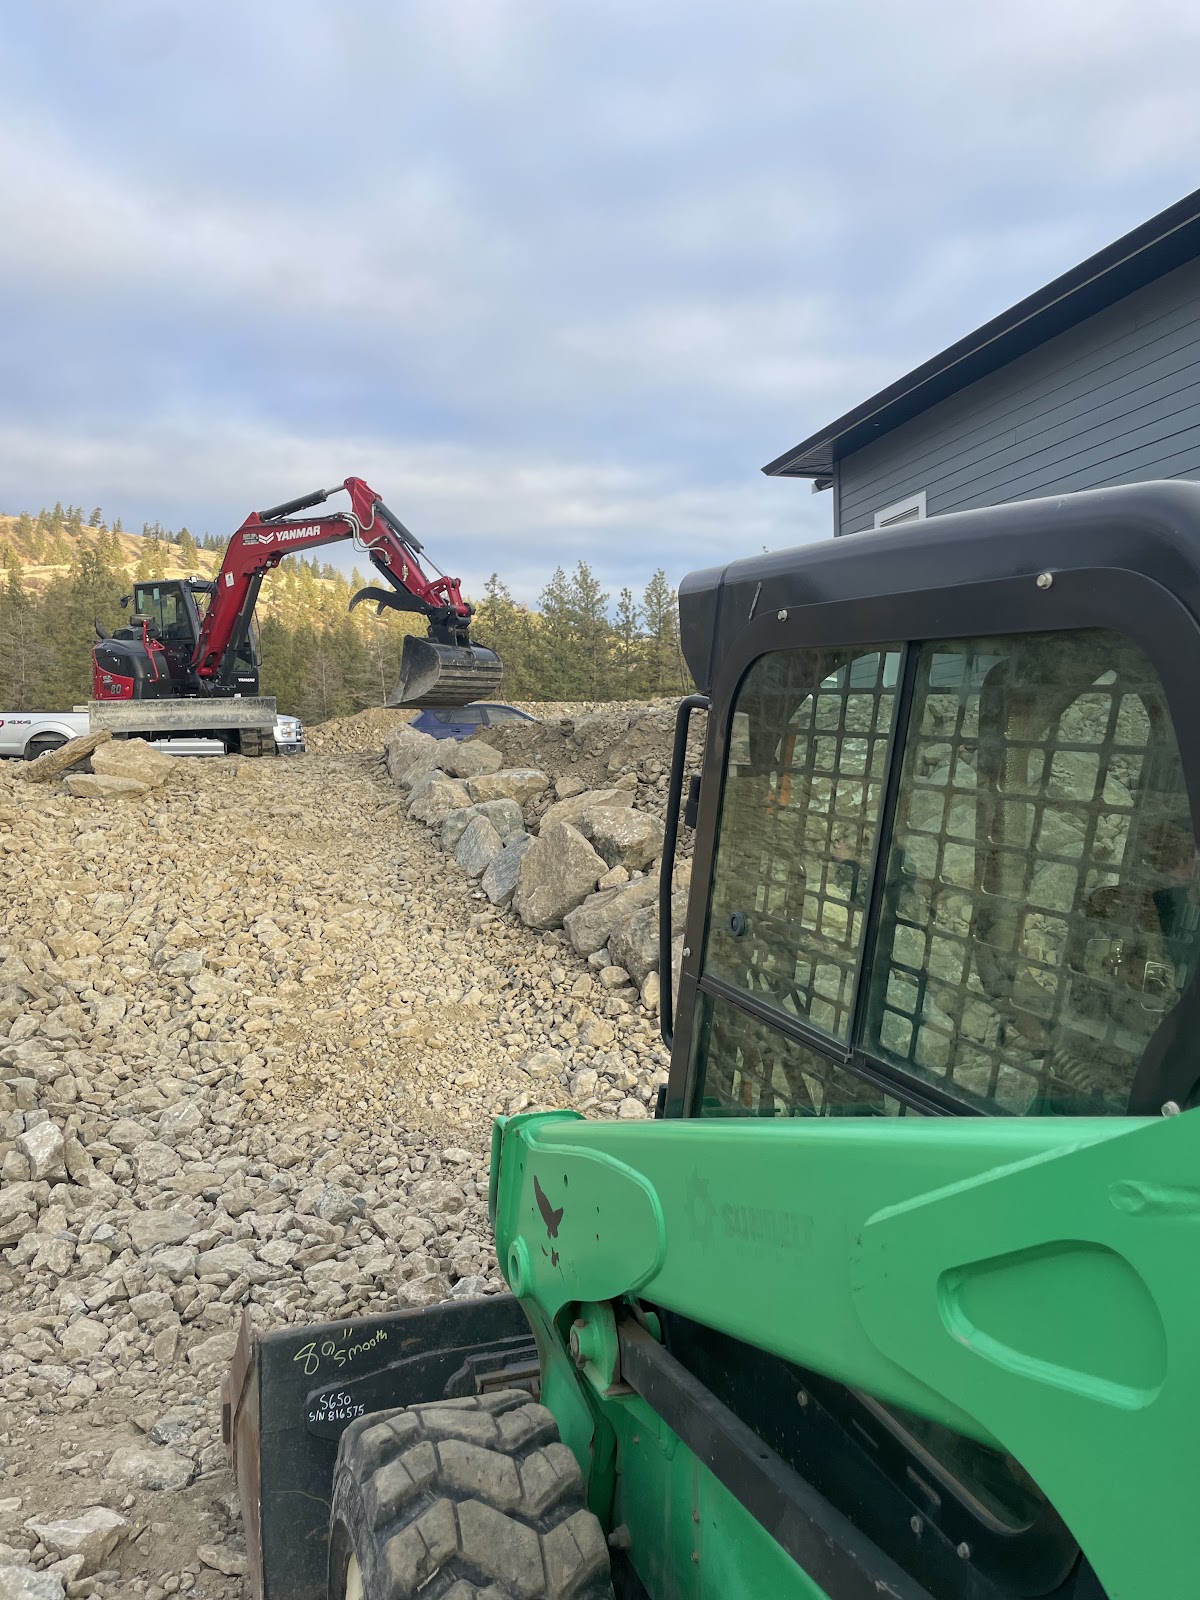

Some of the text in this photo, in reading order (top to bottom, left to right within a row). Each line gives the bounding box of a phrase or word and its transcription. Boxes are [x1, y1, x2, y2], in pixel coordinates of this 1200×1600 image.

[276, 525, 320, 542] YANMAR
[319, 1392, 352, 1411] S650
[308, 1404, 365, 1422] S/N 816575
